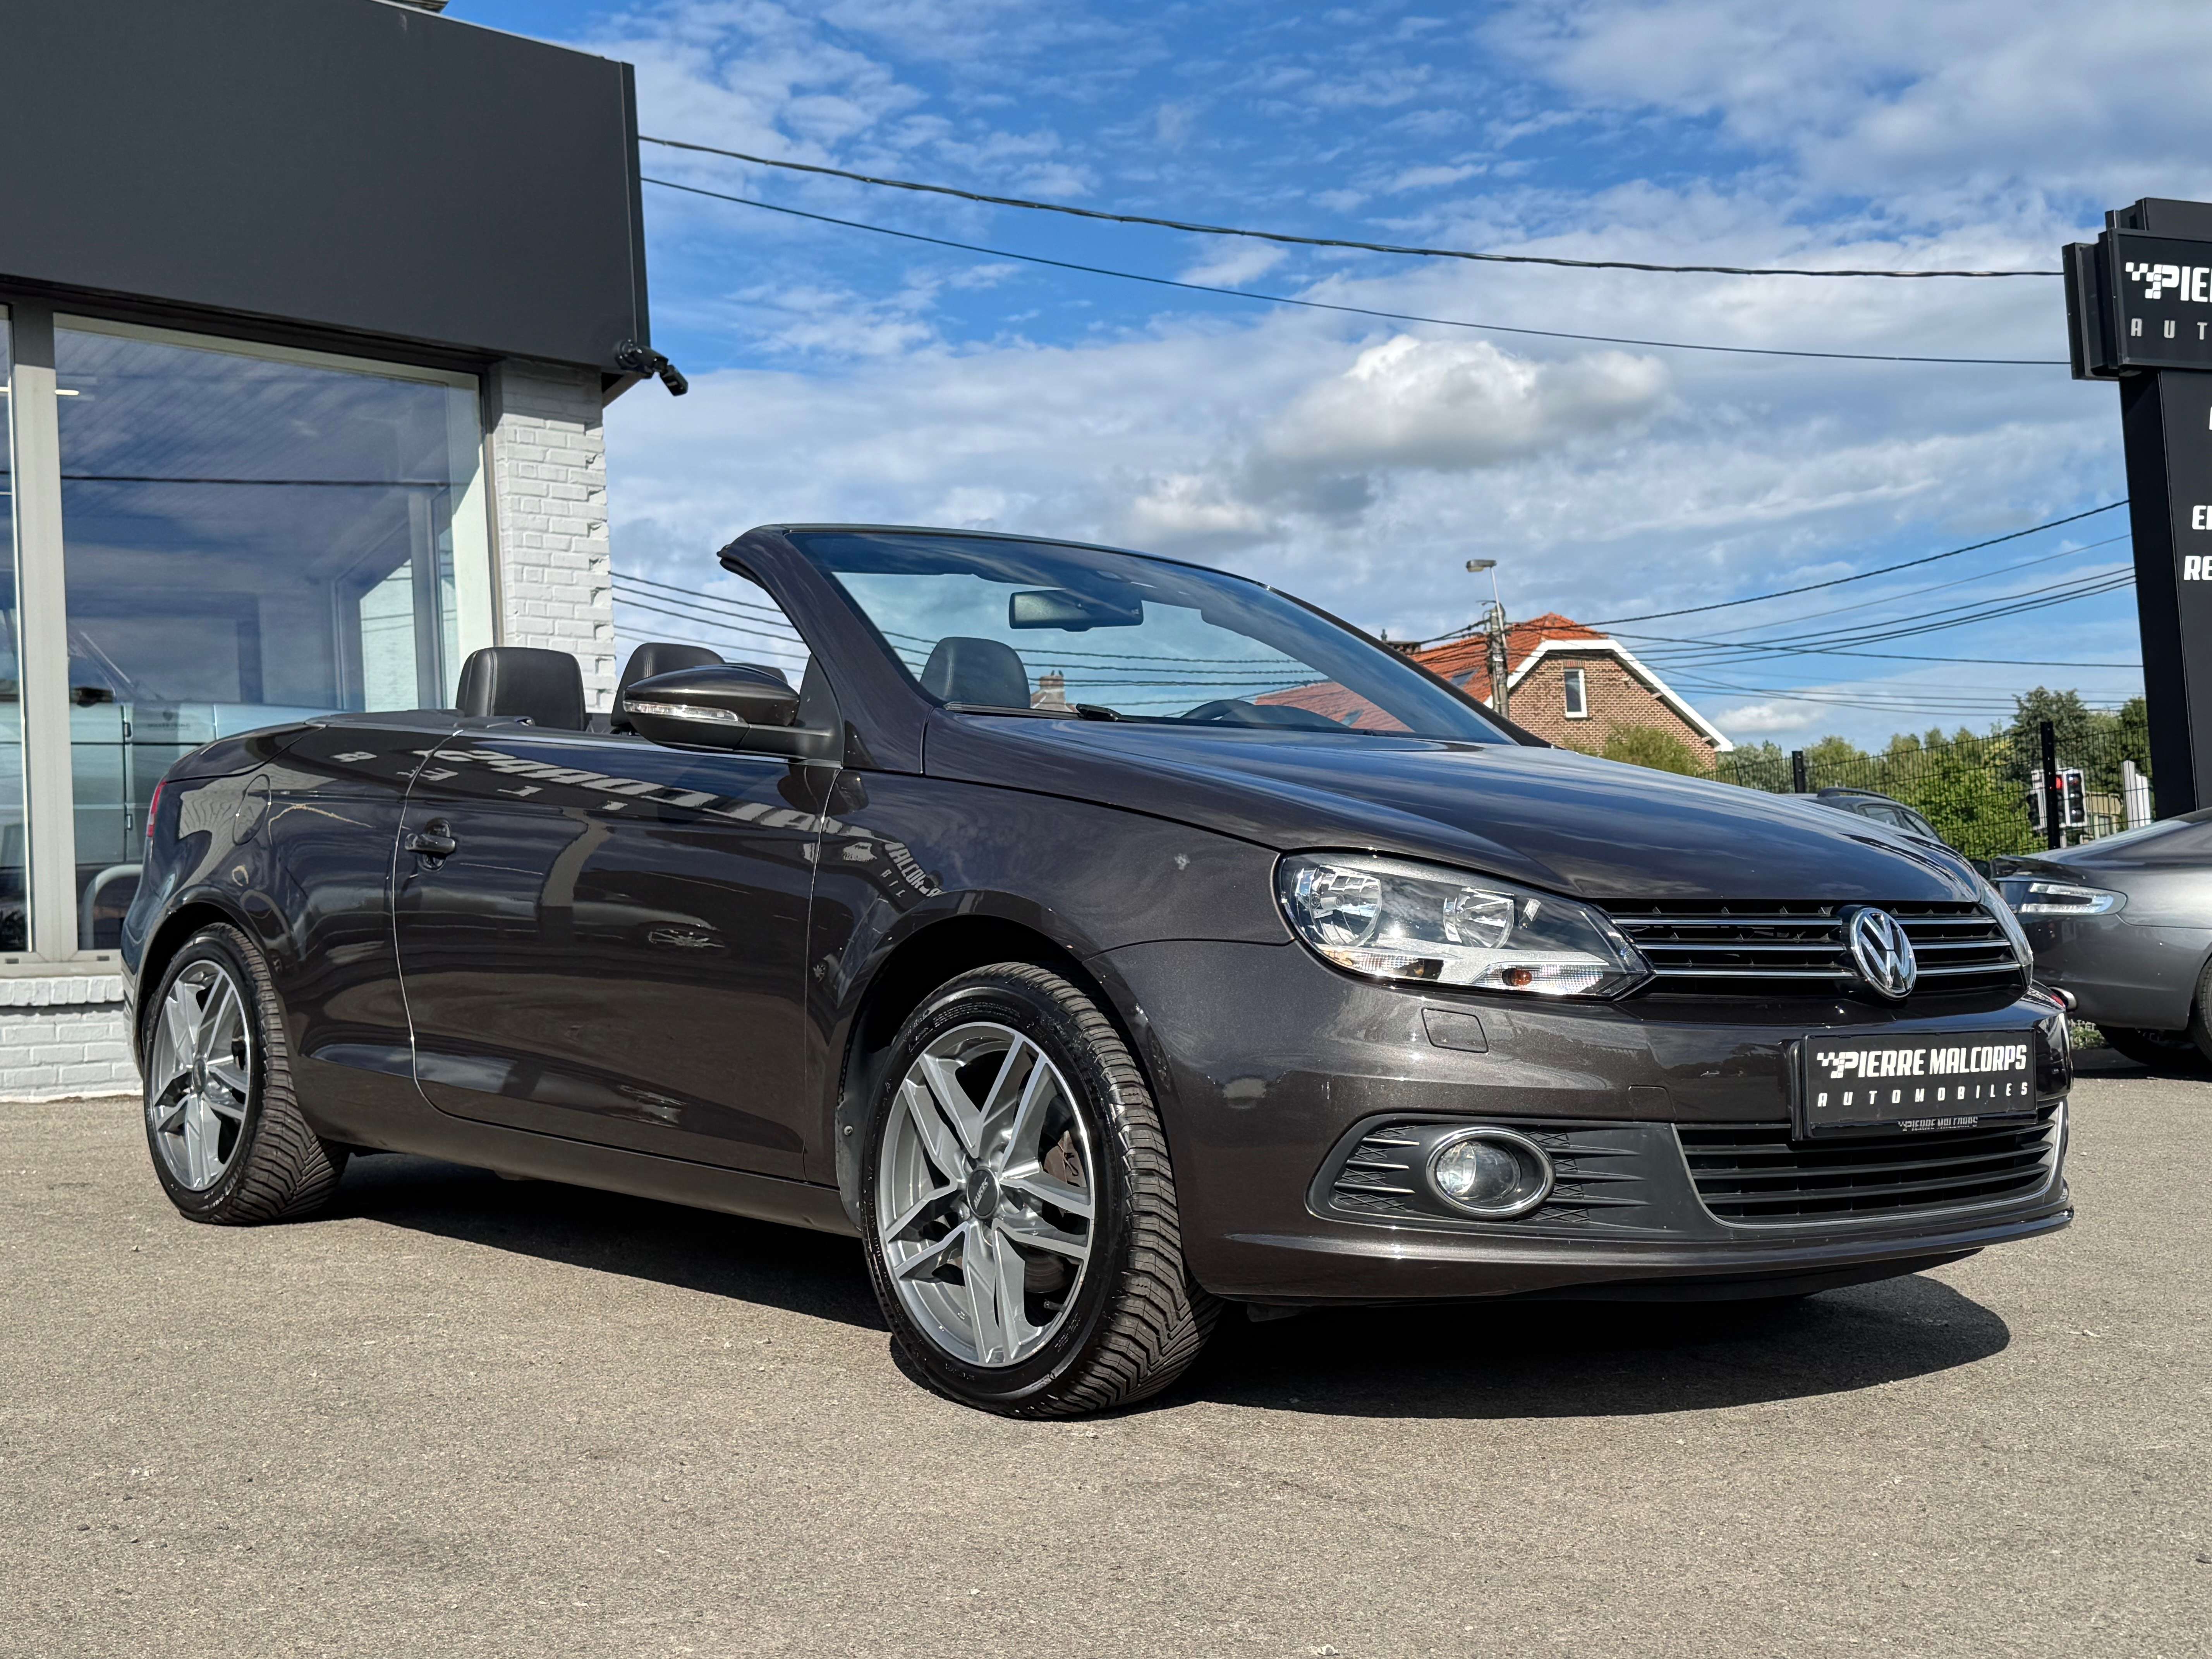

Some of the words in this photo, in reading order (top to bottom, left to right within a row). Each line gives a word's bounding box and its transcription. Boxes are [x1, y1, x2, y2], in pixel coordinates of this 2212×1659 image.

[2125, 262, 2212, 302] PIE
[2131, 318, 2208, 340] AUT
[2184, 555, 2212, 580] RE
[1817, 1049, 1924, 1079] PIERRE
[1929, 1044, 2027, 1075] MALCORPS
[1817, 1082, 2028, 1107] AUTOMOBILES
